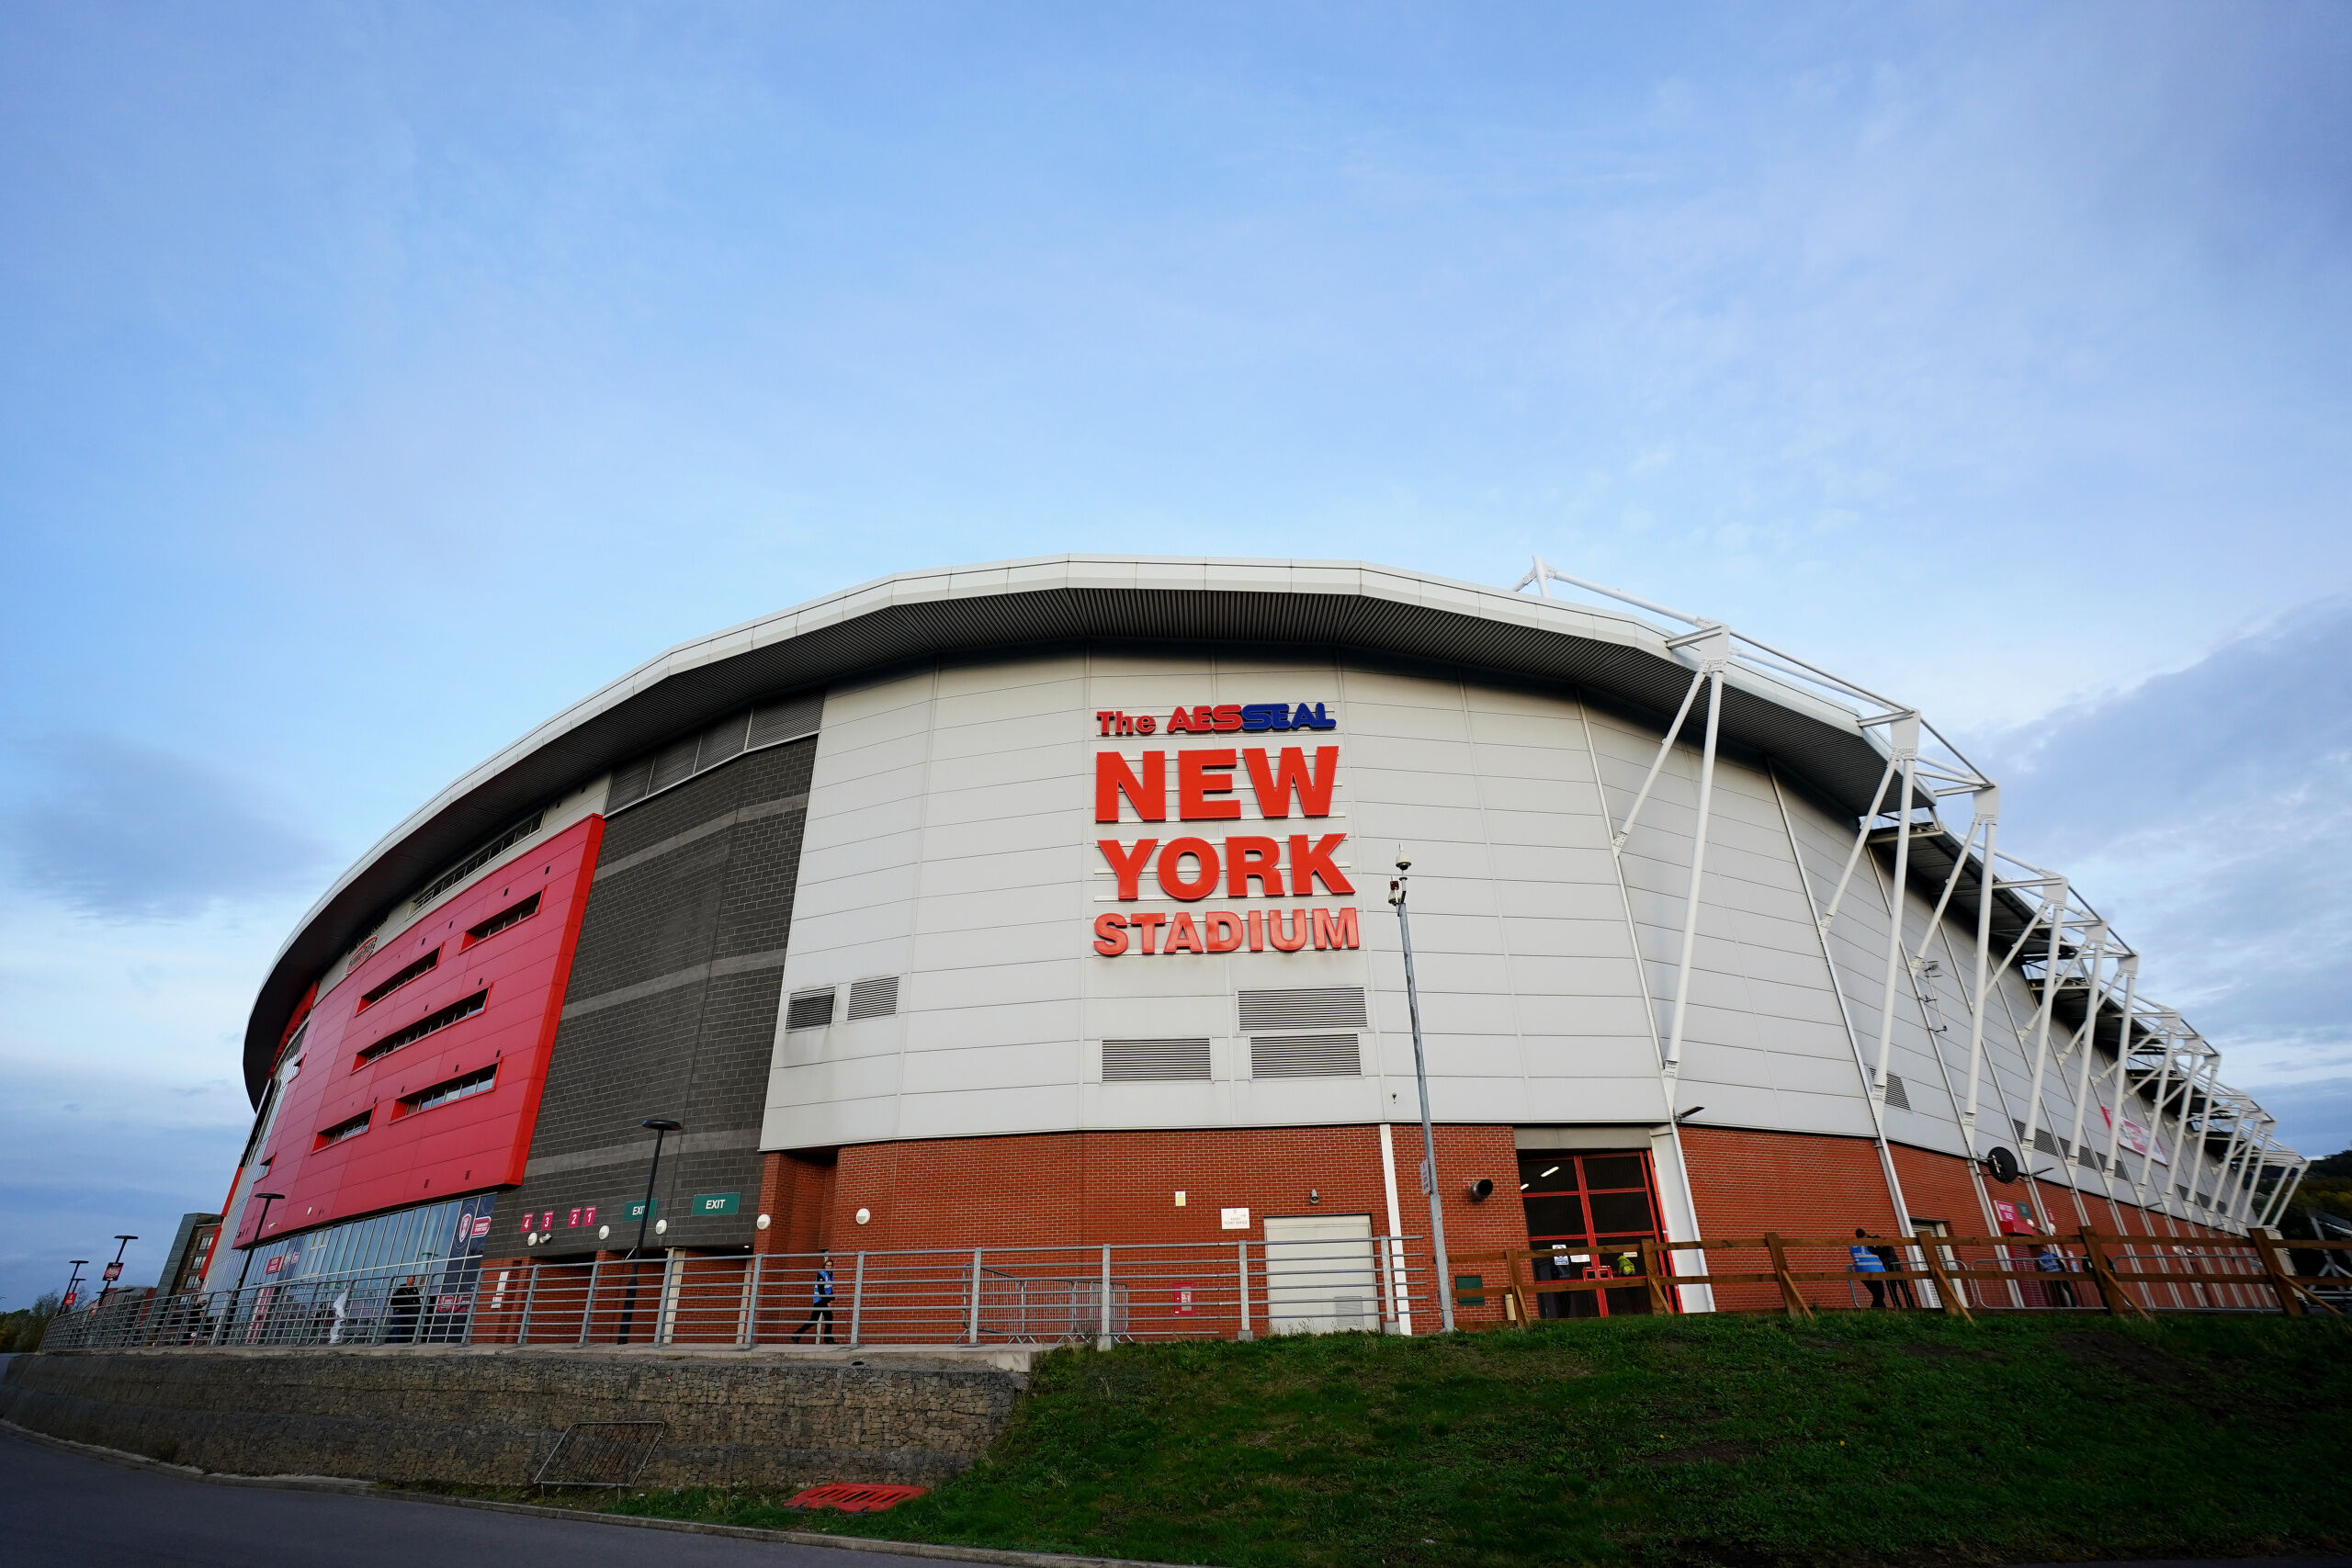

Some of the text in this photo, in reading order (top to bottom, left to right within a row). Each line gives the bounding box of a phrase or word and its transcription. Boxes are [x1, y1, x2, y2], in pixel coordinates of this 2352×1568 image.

[1097, 702, 1337, 735] The AESSEAL
[1095, 746, 1340, 823] NEW
[1097, 833, 1356, 902] YORK
[1093, 908, 1361, 956] STADIUM
[706, 1200, 726, 1210] EXIT
[524, 1218, 530, 1228] 4
[544, 1216, 550, 1227] 3
[571, 1213, 577, 1224] 2
[587, 1212, 593, 1223] 1
